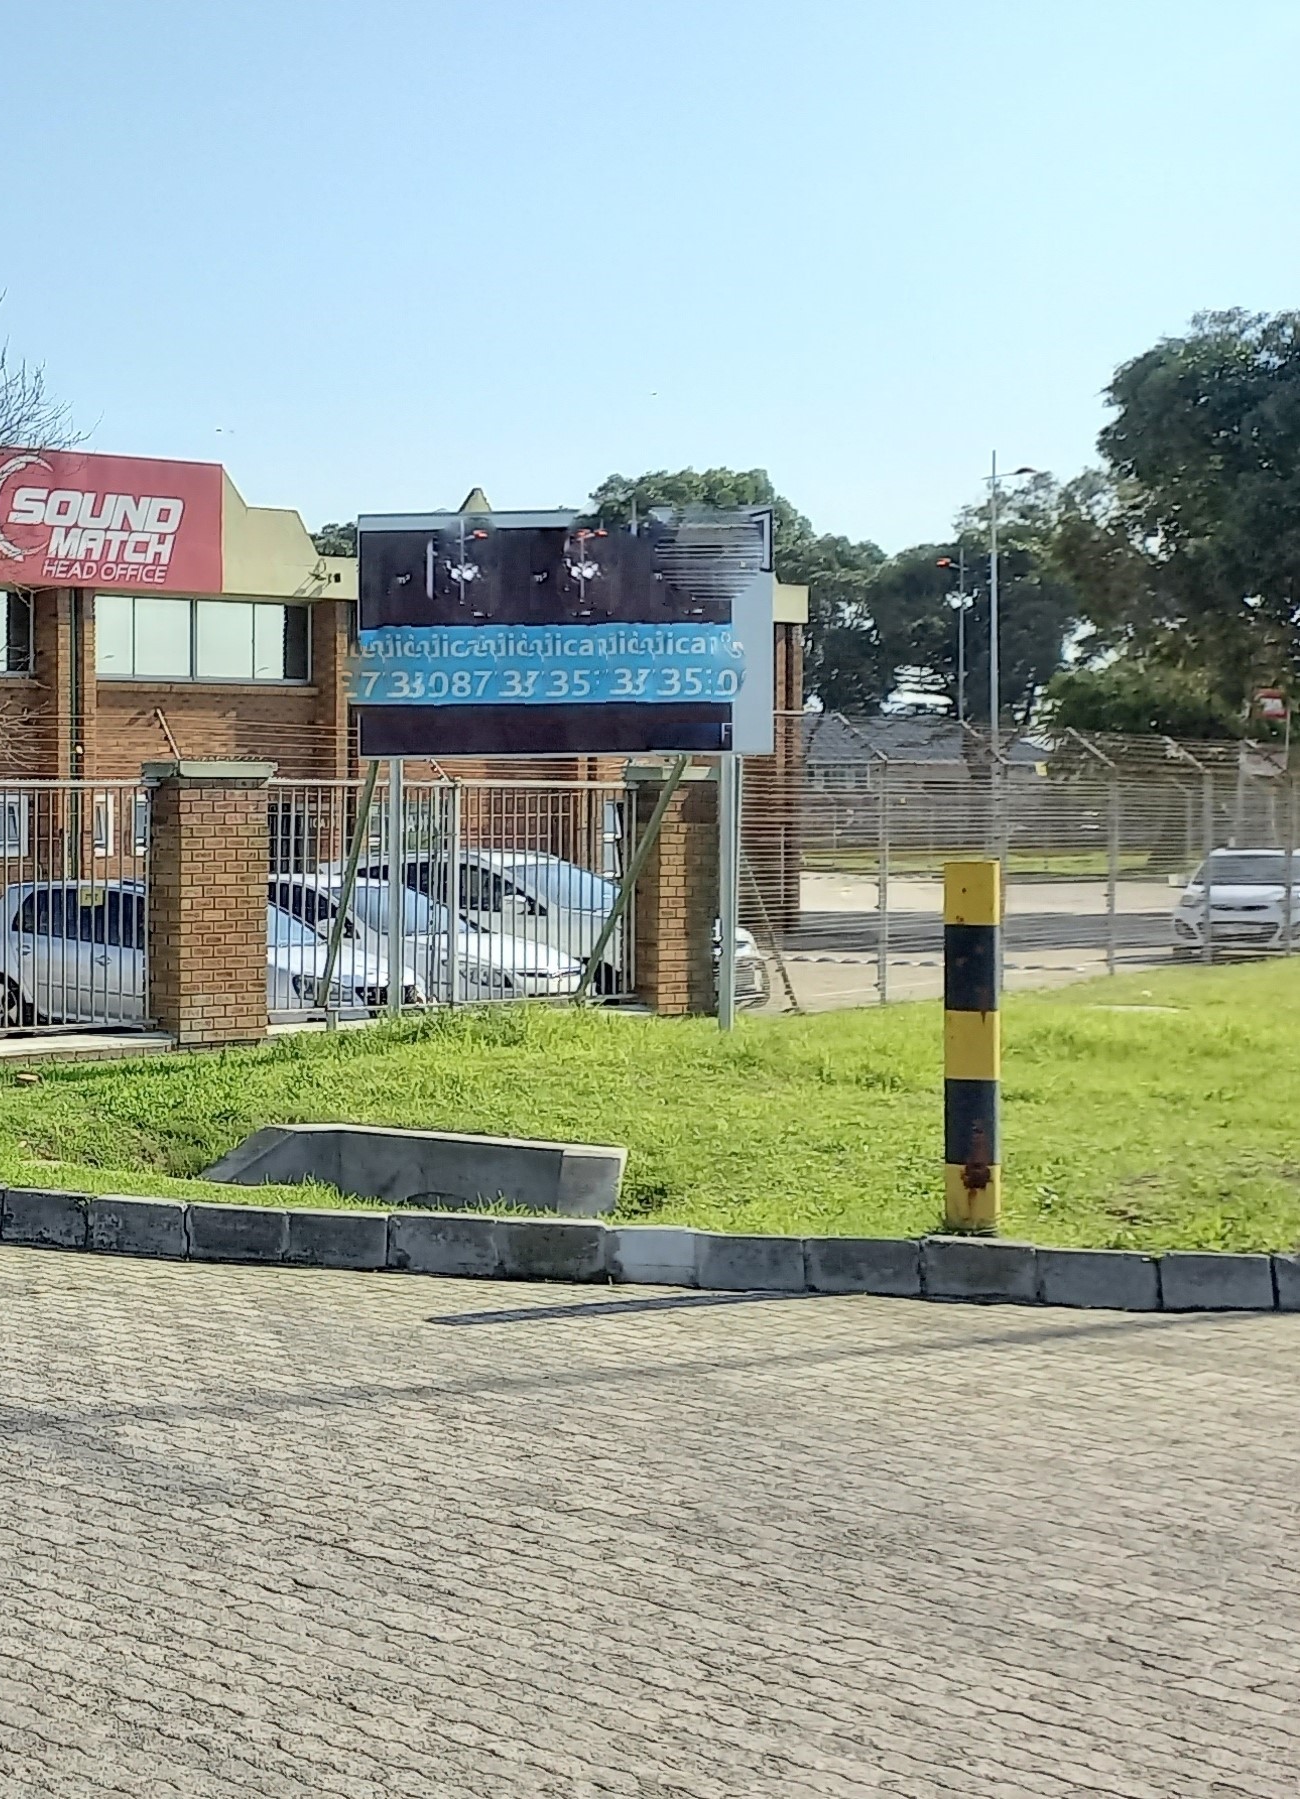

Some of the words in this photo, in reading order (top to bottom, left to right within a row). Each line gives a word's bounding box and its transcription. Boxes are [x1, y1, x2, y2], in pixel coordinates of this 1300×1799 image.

[7, 487, 184, 535] SOUND
[47, 527, 175, 565] MATCH
[42, 560, 97, 580] HEAD
[100, 563, 168, 584] OFFICE
